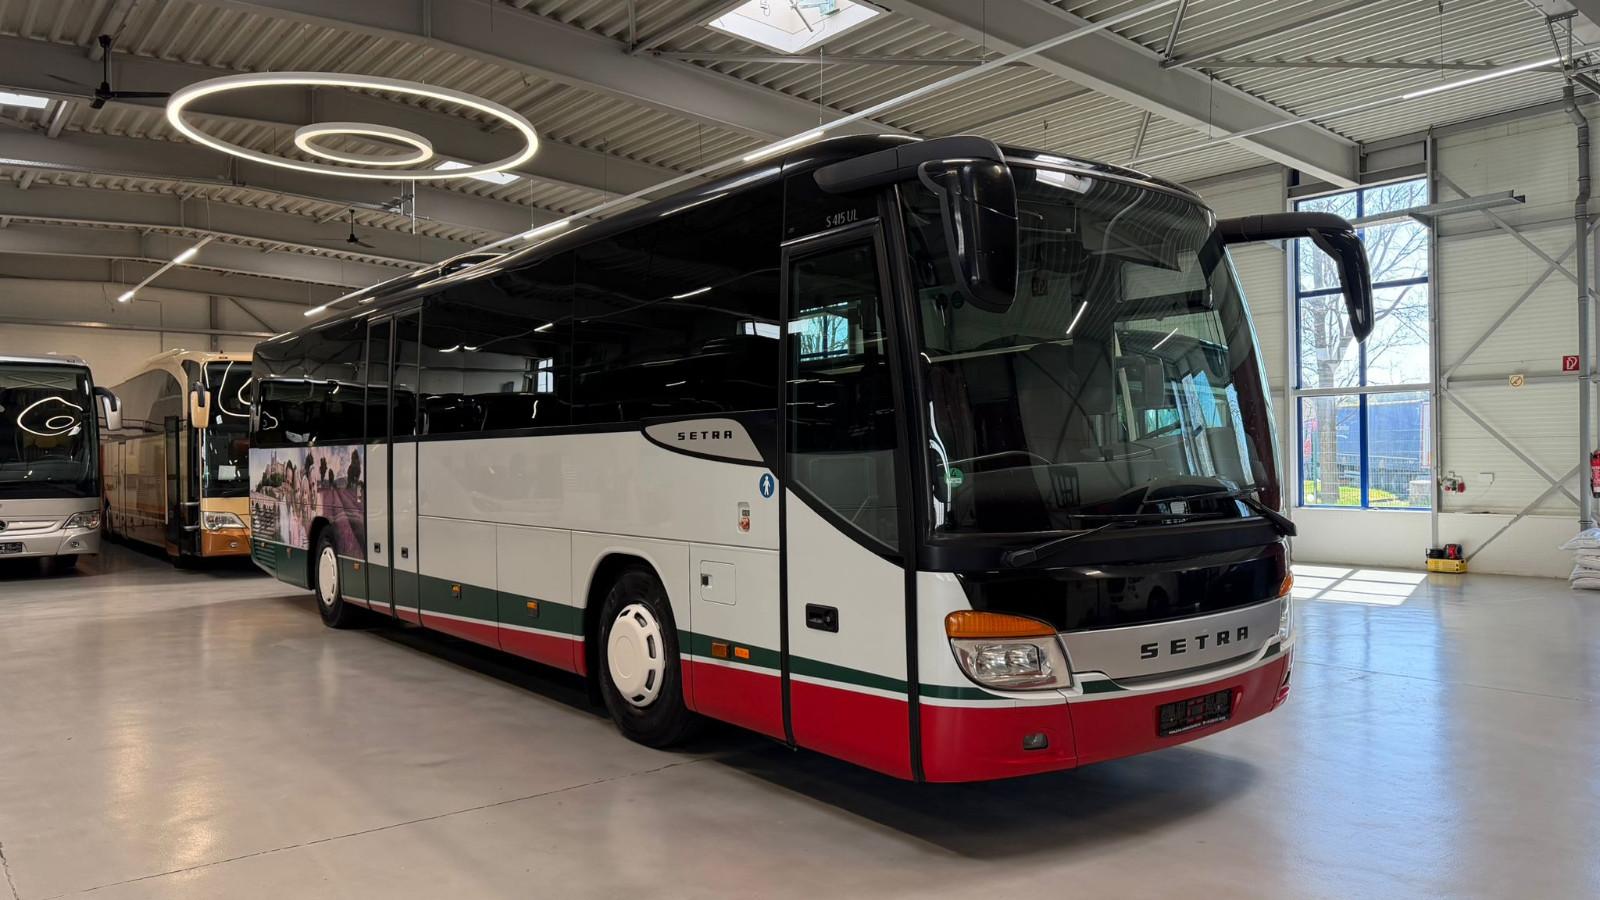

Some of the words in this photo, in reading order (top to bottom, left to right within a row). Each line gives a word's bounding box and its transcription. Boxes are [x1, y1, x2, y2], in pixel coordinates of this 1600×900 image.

[826, 215, 831, 228] S
[832, 211, 846, 226] 415
[847, 208, 859, 222] UL
[677, 430, 733, 441] SETRA
[1140, 626, 1249, 660] SETRA
